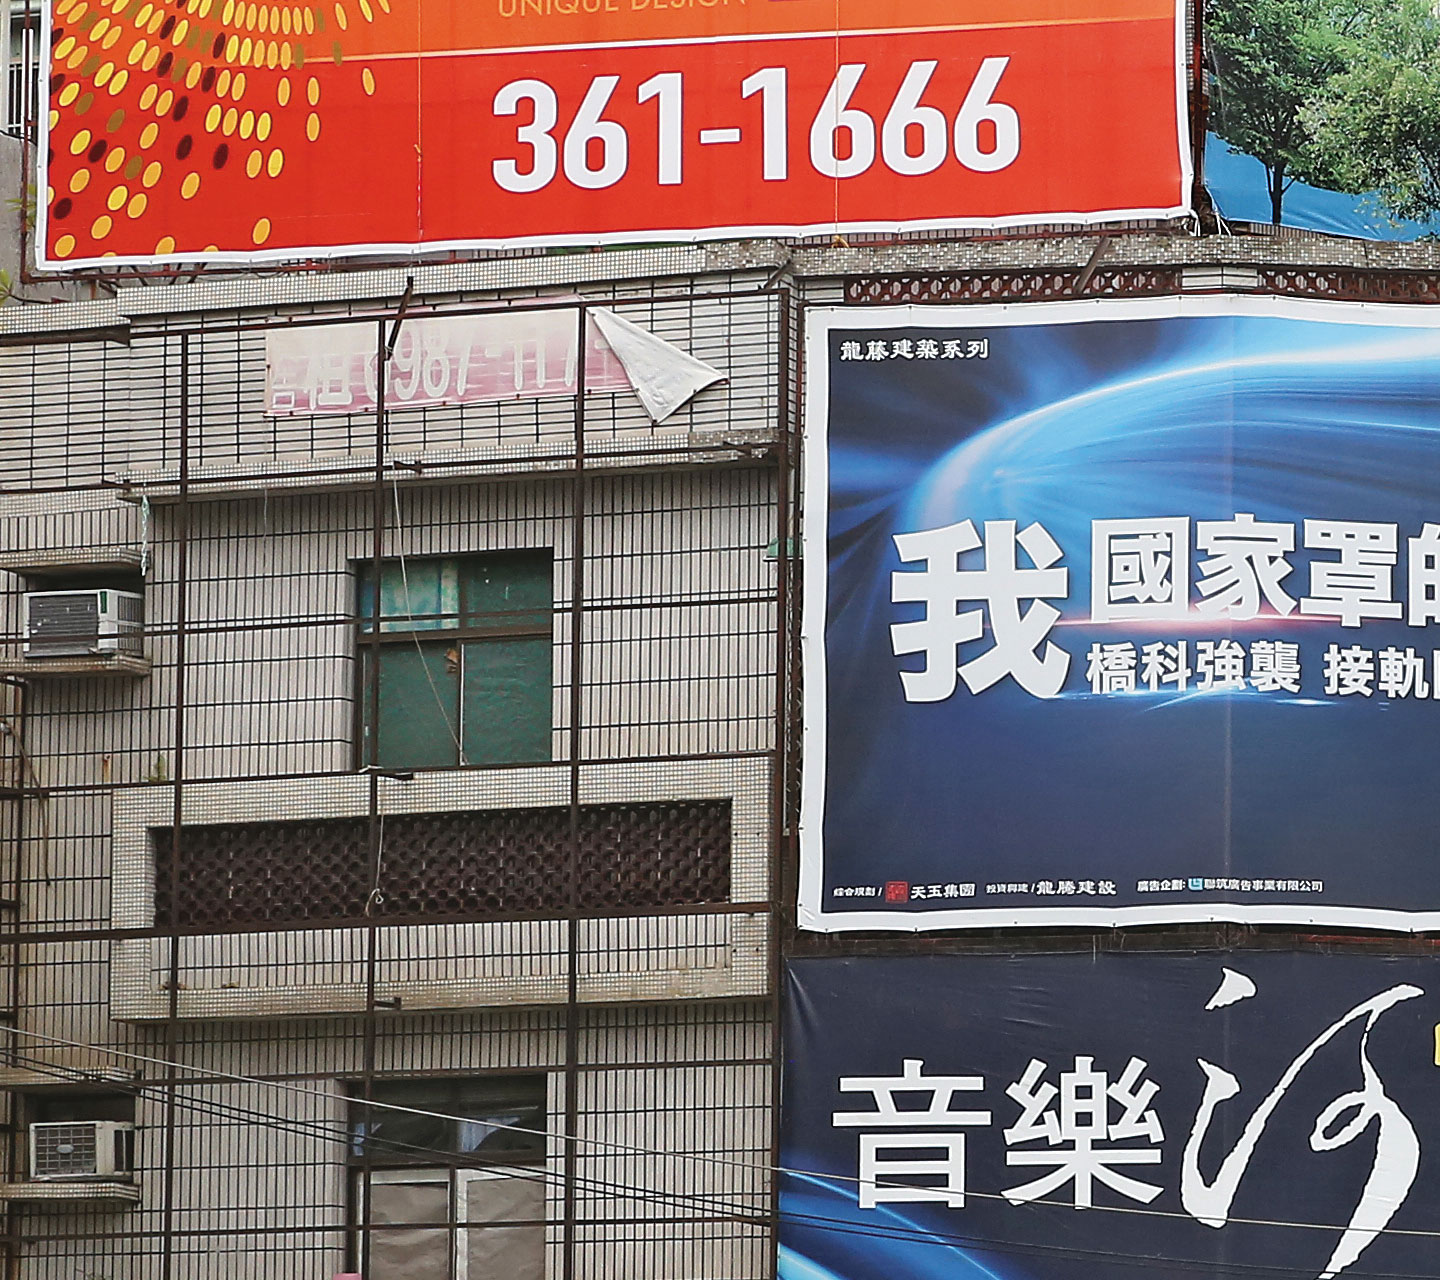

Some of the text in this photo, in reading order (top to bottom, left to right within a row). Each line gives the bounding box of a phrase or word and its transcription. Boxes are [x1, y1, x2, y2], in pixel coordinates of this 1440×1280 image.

[492, 53, 1022, 196] 361-1666
[888, 516, 1073, 704] 我
[1086, 636, 1302, 701] 橋科強襲
